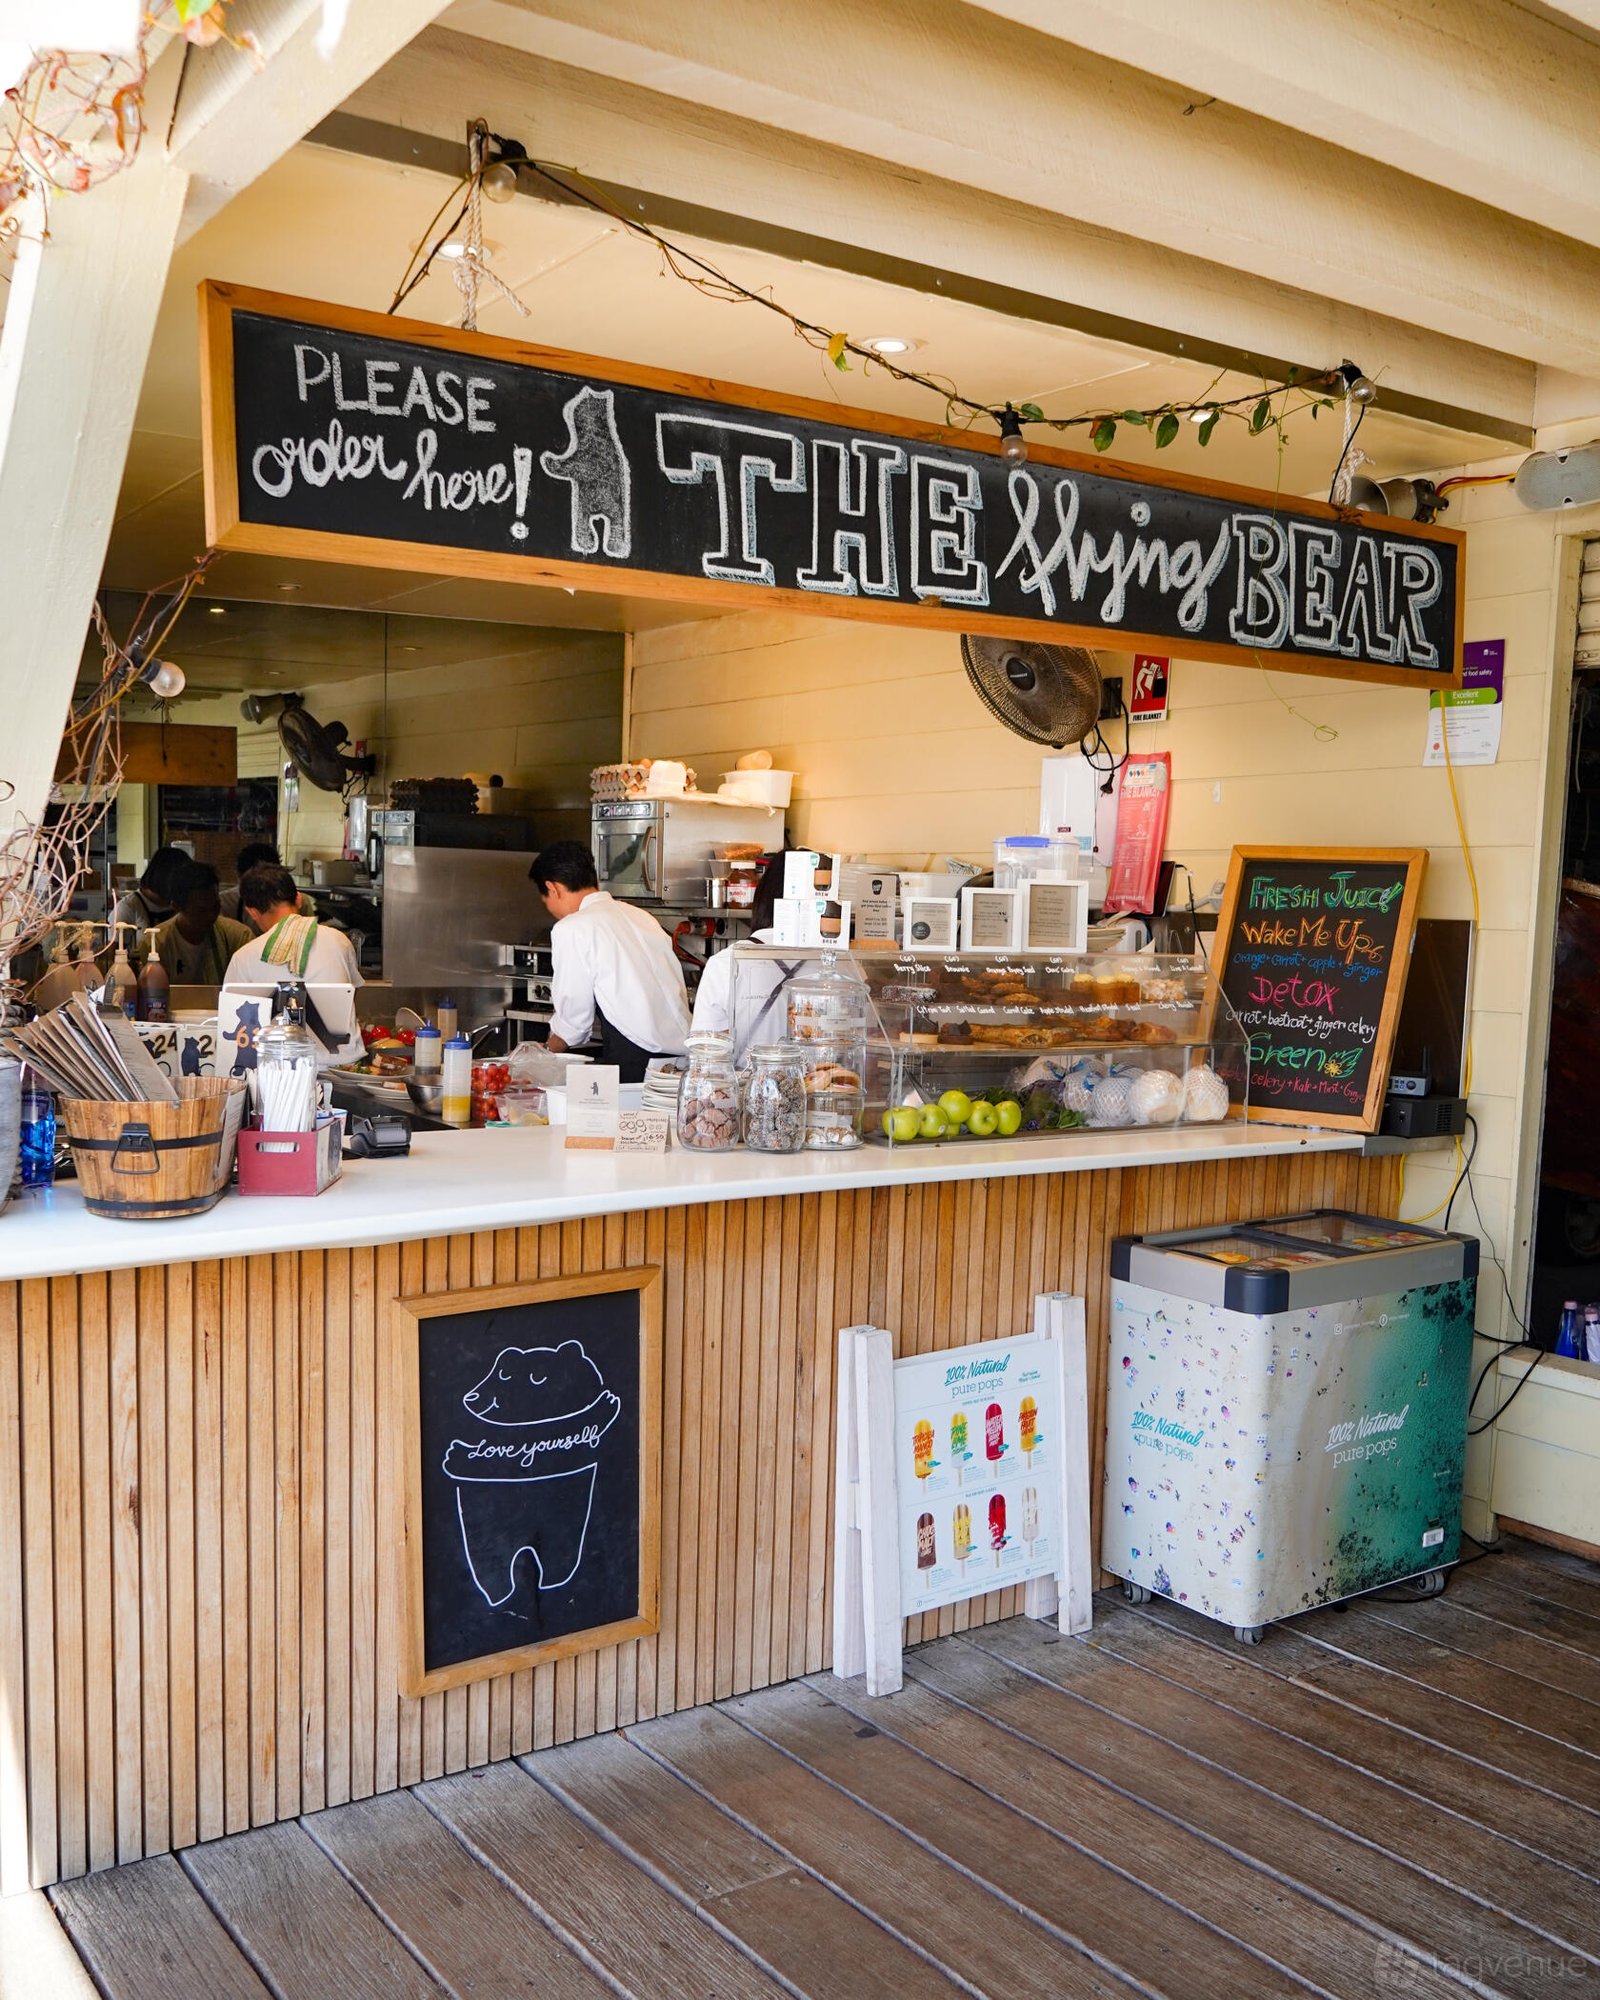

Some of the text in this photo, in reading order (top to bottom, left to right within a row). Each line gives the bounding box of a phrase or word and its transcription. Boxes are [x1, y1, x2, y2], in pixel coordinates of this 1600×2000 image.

[294, 343, 498, 434] PLEASE
[252, 417, 533, 541] order here!
[655, 412, 991, 606] THE
[1228, 513, 1443, 669] BEAR
[1453, 691, 1479, 699] Excellent
[1249, 876, 1320, 911] FRESH
[1240, 919, 1296, 947] Wake
[1296, 914, 1332, 947] Me
[1248, 972, 1341, 1016] Detox
[154, 1031, 178, 1059] 24
[198, 1034, 217, 1059] 2
[1244, 1031, 1346, 1072] Green
[944, 1364, 968, 1387] 100%
[967, 1353, 1011, 1380] Natural
[951, 1383, 977, 1399] pure
[977, 1376, 1004, 1394] pops
[1131, 1411, 1205, 1447] 100% Natural
[1324, 1404, 1409, 1452] 100% Natural
[468, 1425, 601, 1468] Love yourself
[1136, 1433, 1194, 1461] pure pops
[1333, 1437, 1398, 1469] pure pops
